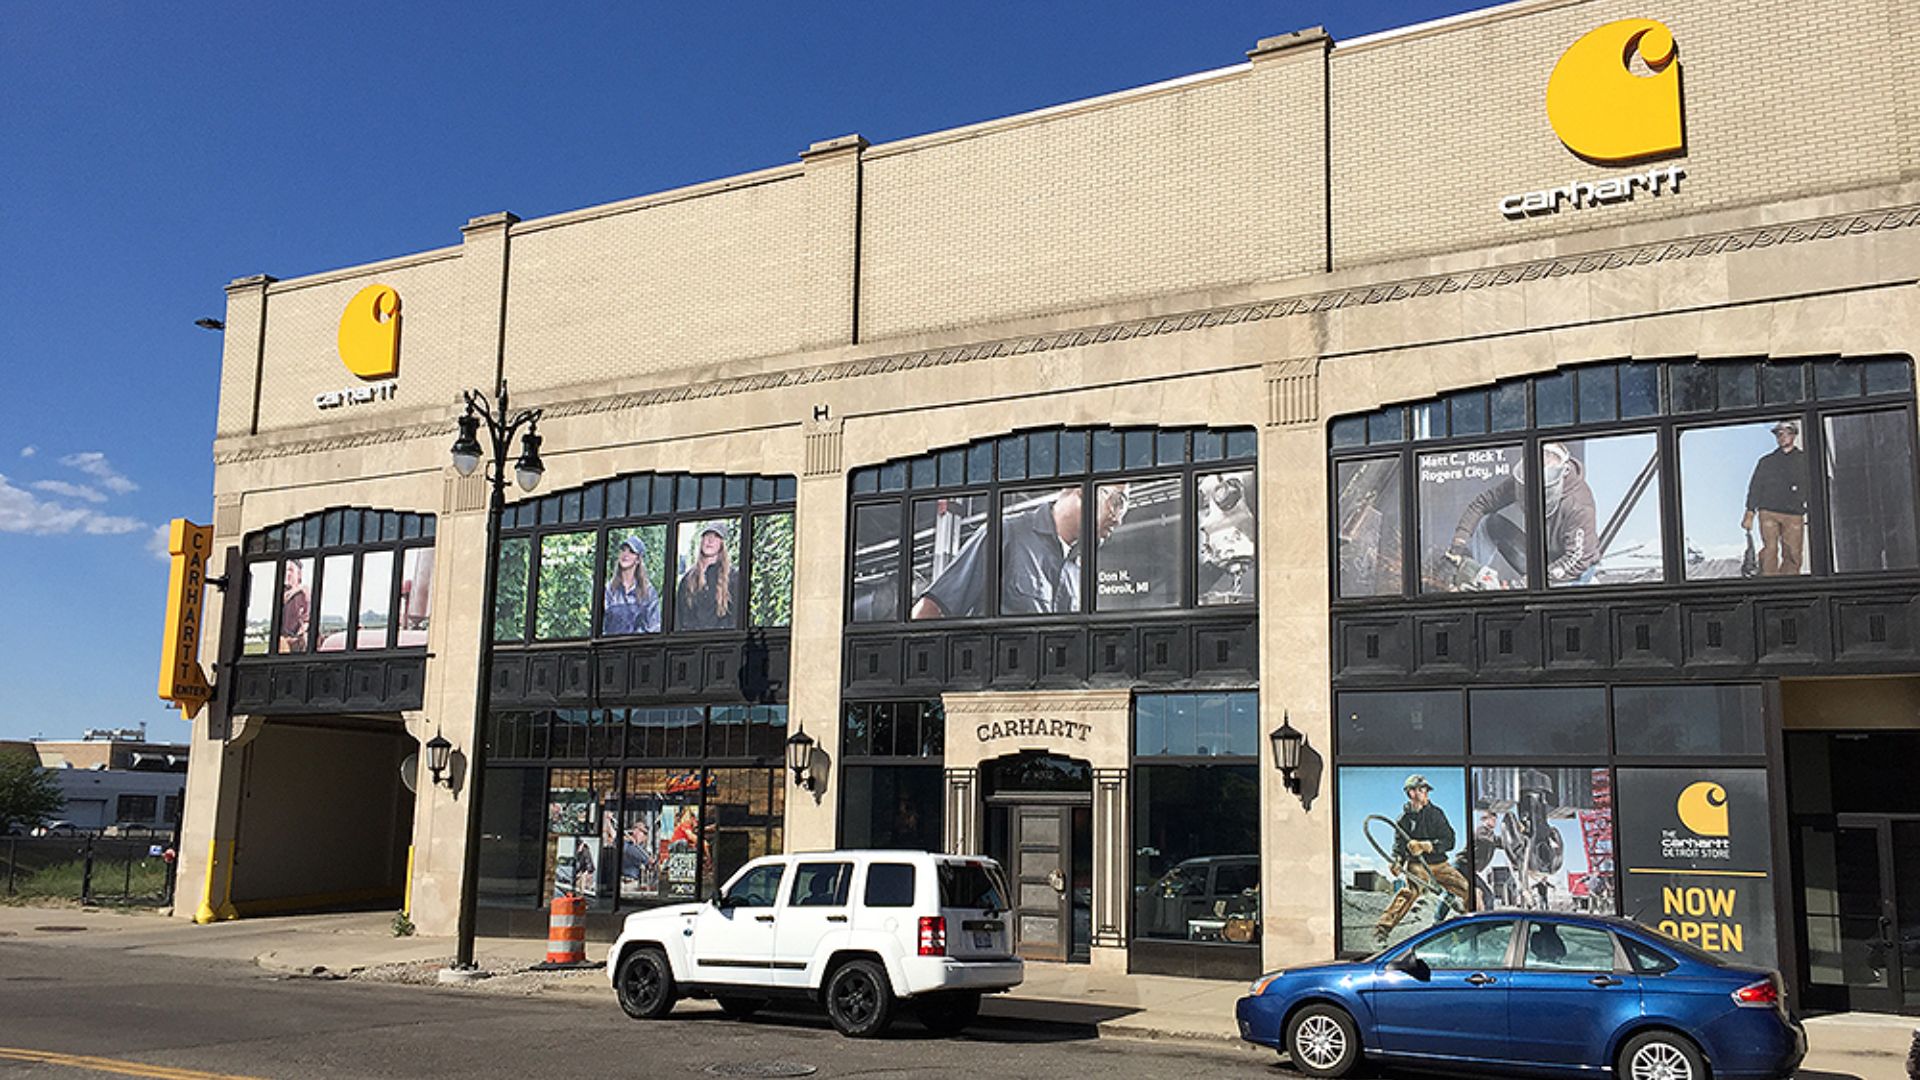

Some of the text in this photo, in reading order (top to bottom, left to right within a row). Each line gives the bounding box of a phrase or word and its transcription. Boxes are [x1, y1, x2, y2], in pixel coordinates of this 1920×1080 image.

[1499, 165, 1687, 220] carhartt
[312, 381, 398, 409] carhartt
[1422, 455, 1448, 467] Matt
[1422, 470, 1463, 483] Rogers
[1495, 463, 1510, 475] MI
[1136, 581, 1149, 592] MI
[181, 533, 204, 679] CARHARTT
[176, 683, 206, 696] ENTER
[976, 717, 1091, 742] CARHARTT
[1661, 837, 1730, 849] carhartt
[1662, 848, 1731, 860] DETROIT STORE
[1662, 885, 1736, 918] NOW
[1658, 920, 1744, 952] OPEN
